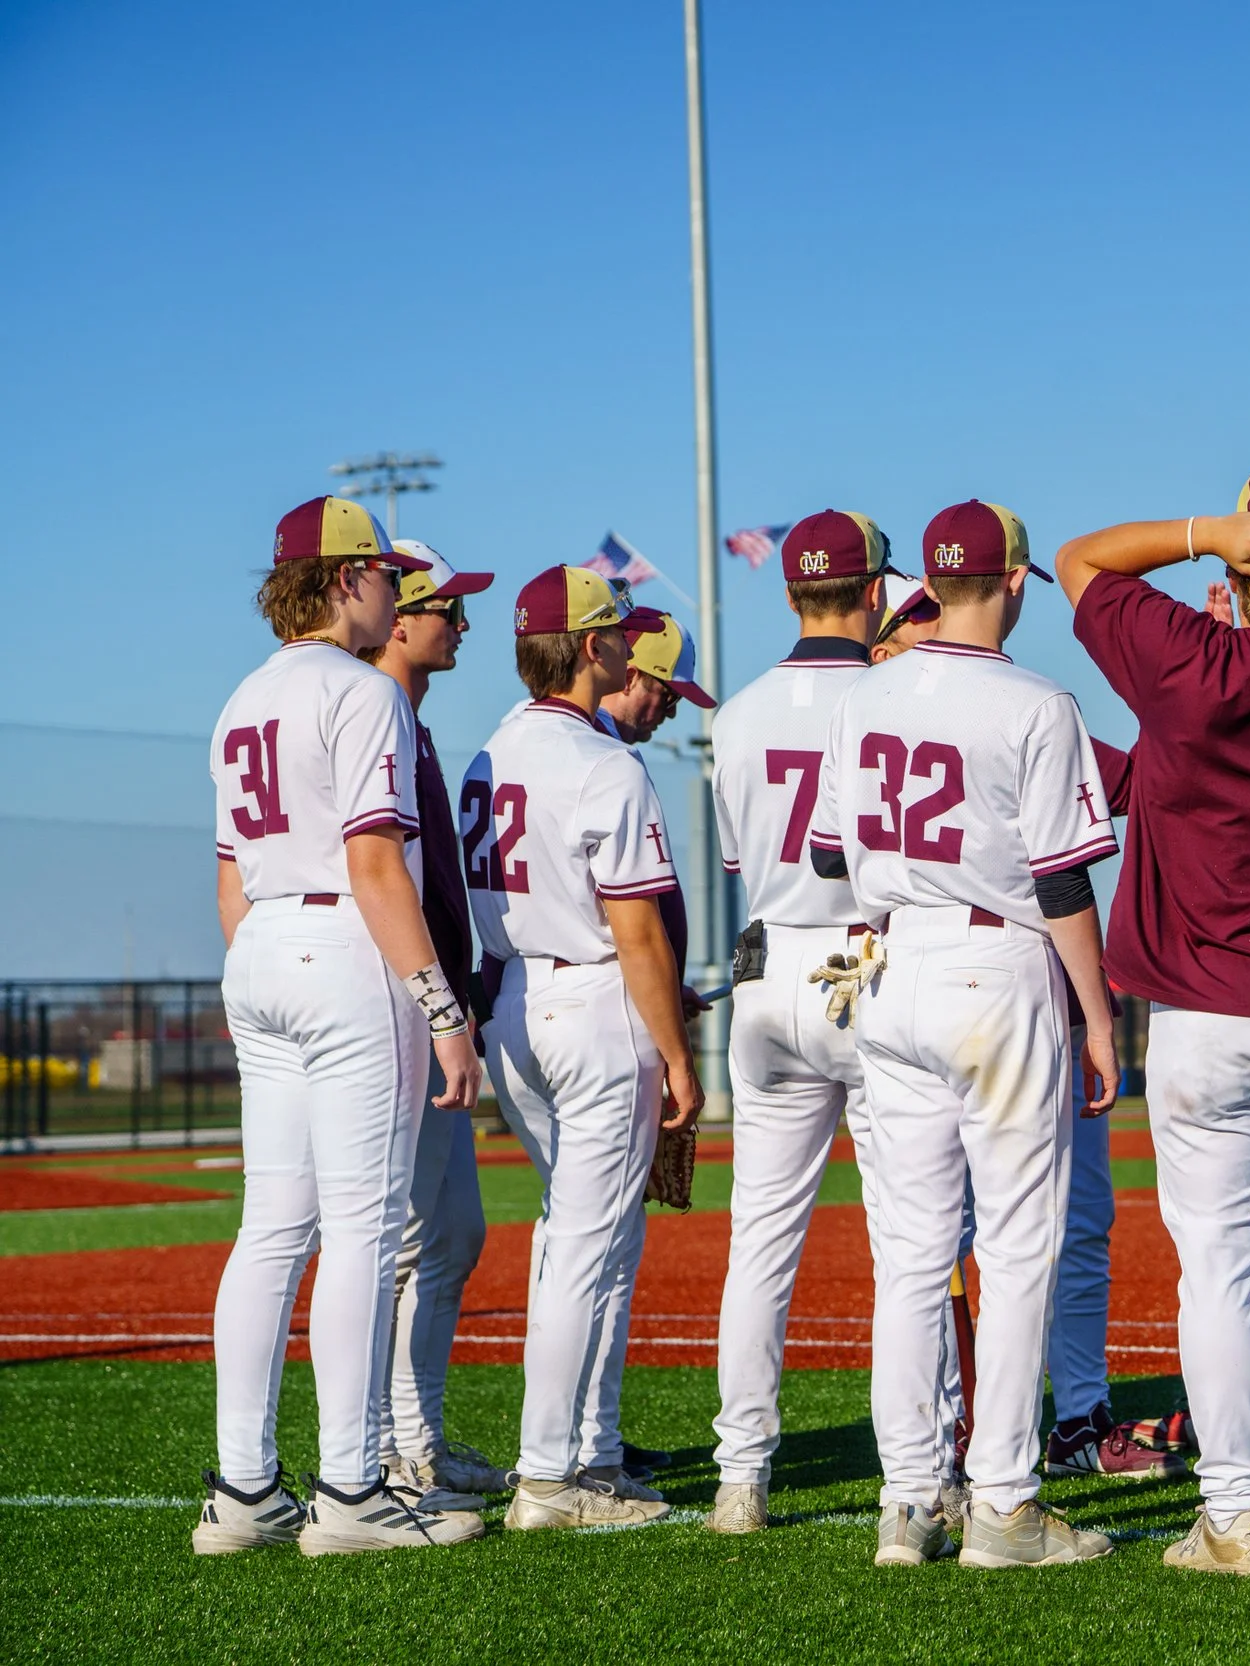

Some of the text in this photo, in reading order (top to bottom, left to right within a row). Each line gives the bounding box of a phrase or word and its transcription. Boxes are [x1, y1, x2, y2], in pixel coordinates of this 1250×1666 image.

[224, 719, 290, 840] 31
[461, 779, 530, 894] 22
[765, 748, 824, 864] 7
[857, 731, 965, 865] 32
